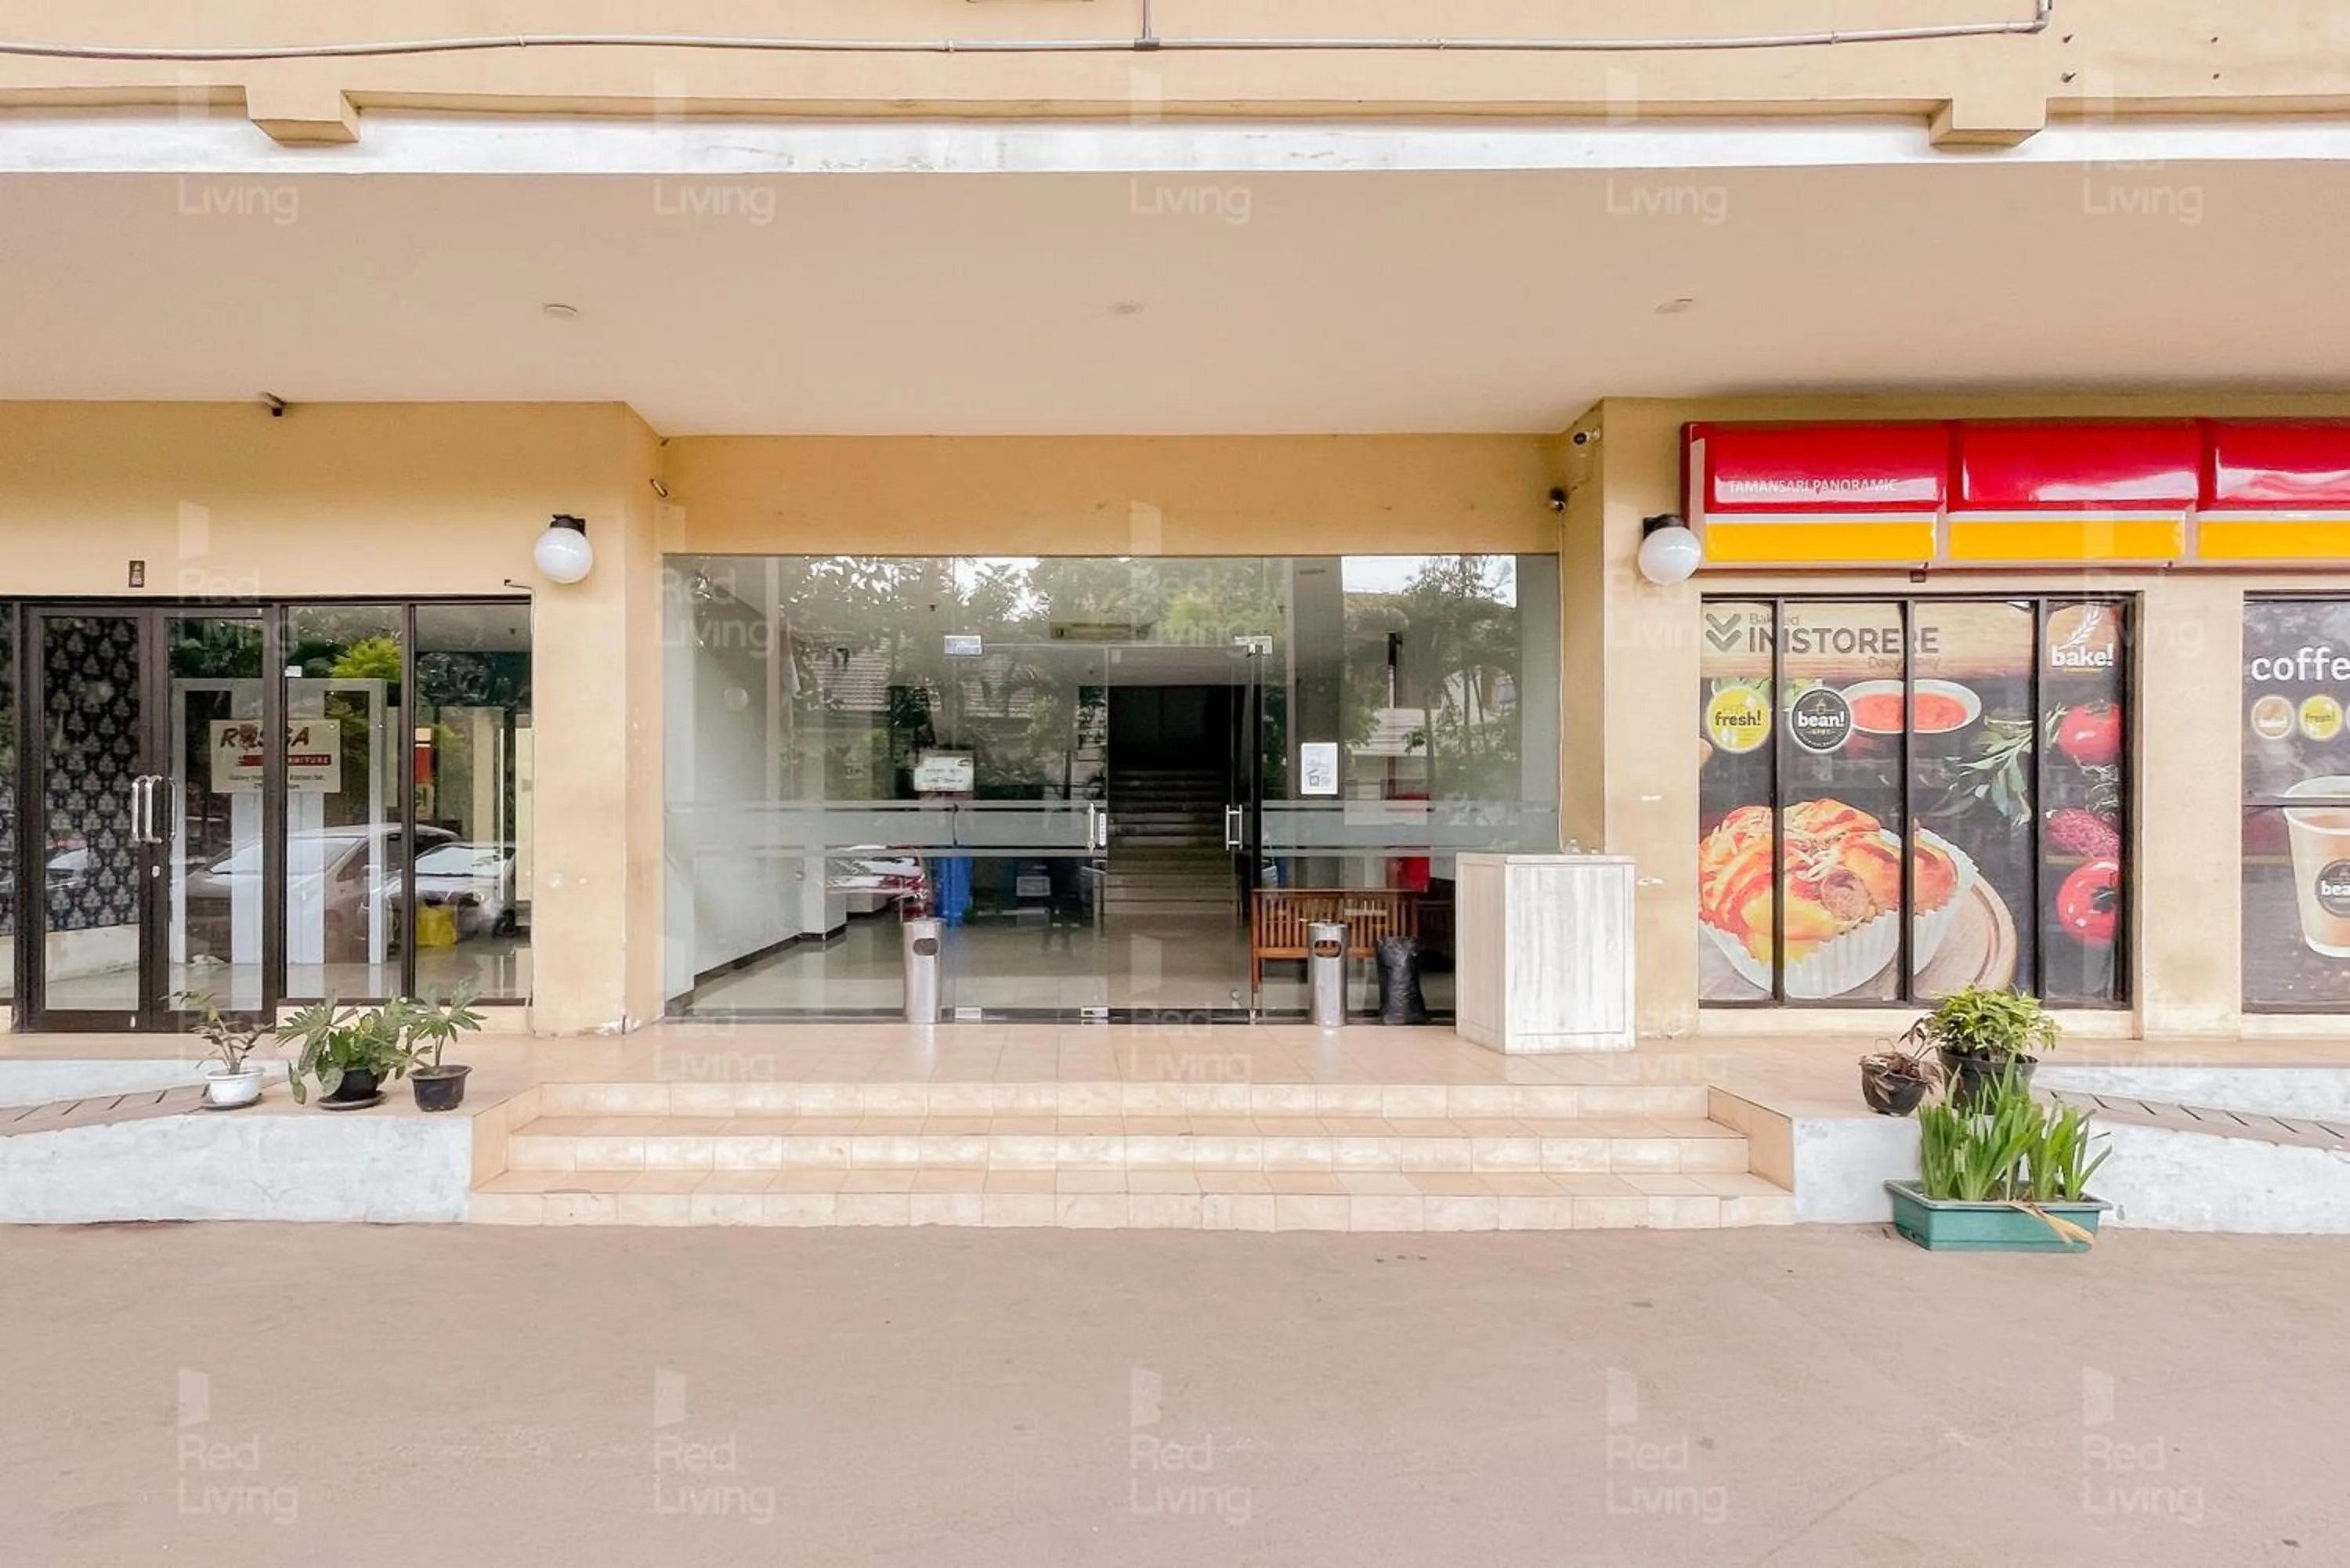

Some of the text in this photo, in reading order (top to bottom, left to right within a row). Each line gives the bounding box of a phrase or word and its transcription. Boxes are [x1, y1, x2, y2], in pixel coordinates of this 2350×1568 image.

[1729, 479, 1898, 493] TAMANSARI PANORAMIC
[2051, 642, 2113, 667] bake!
[1715, 710, 1761, 726] fresh!
[1798, 710, 1845, 728] bean!
